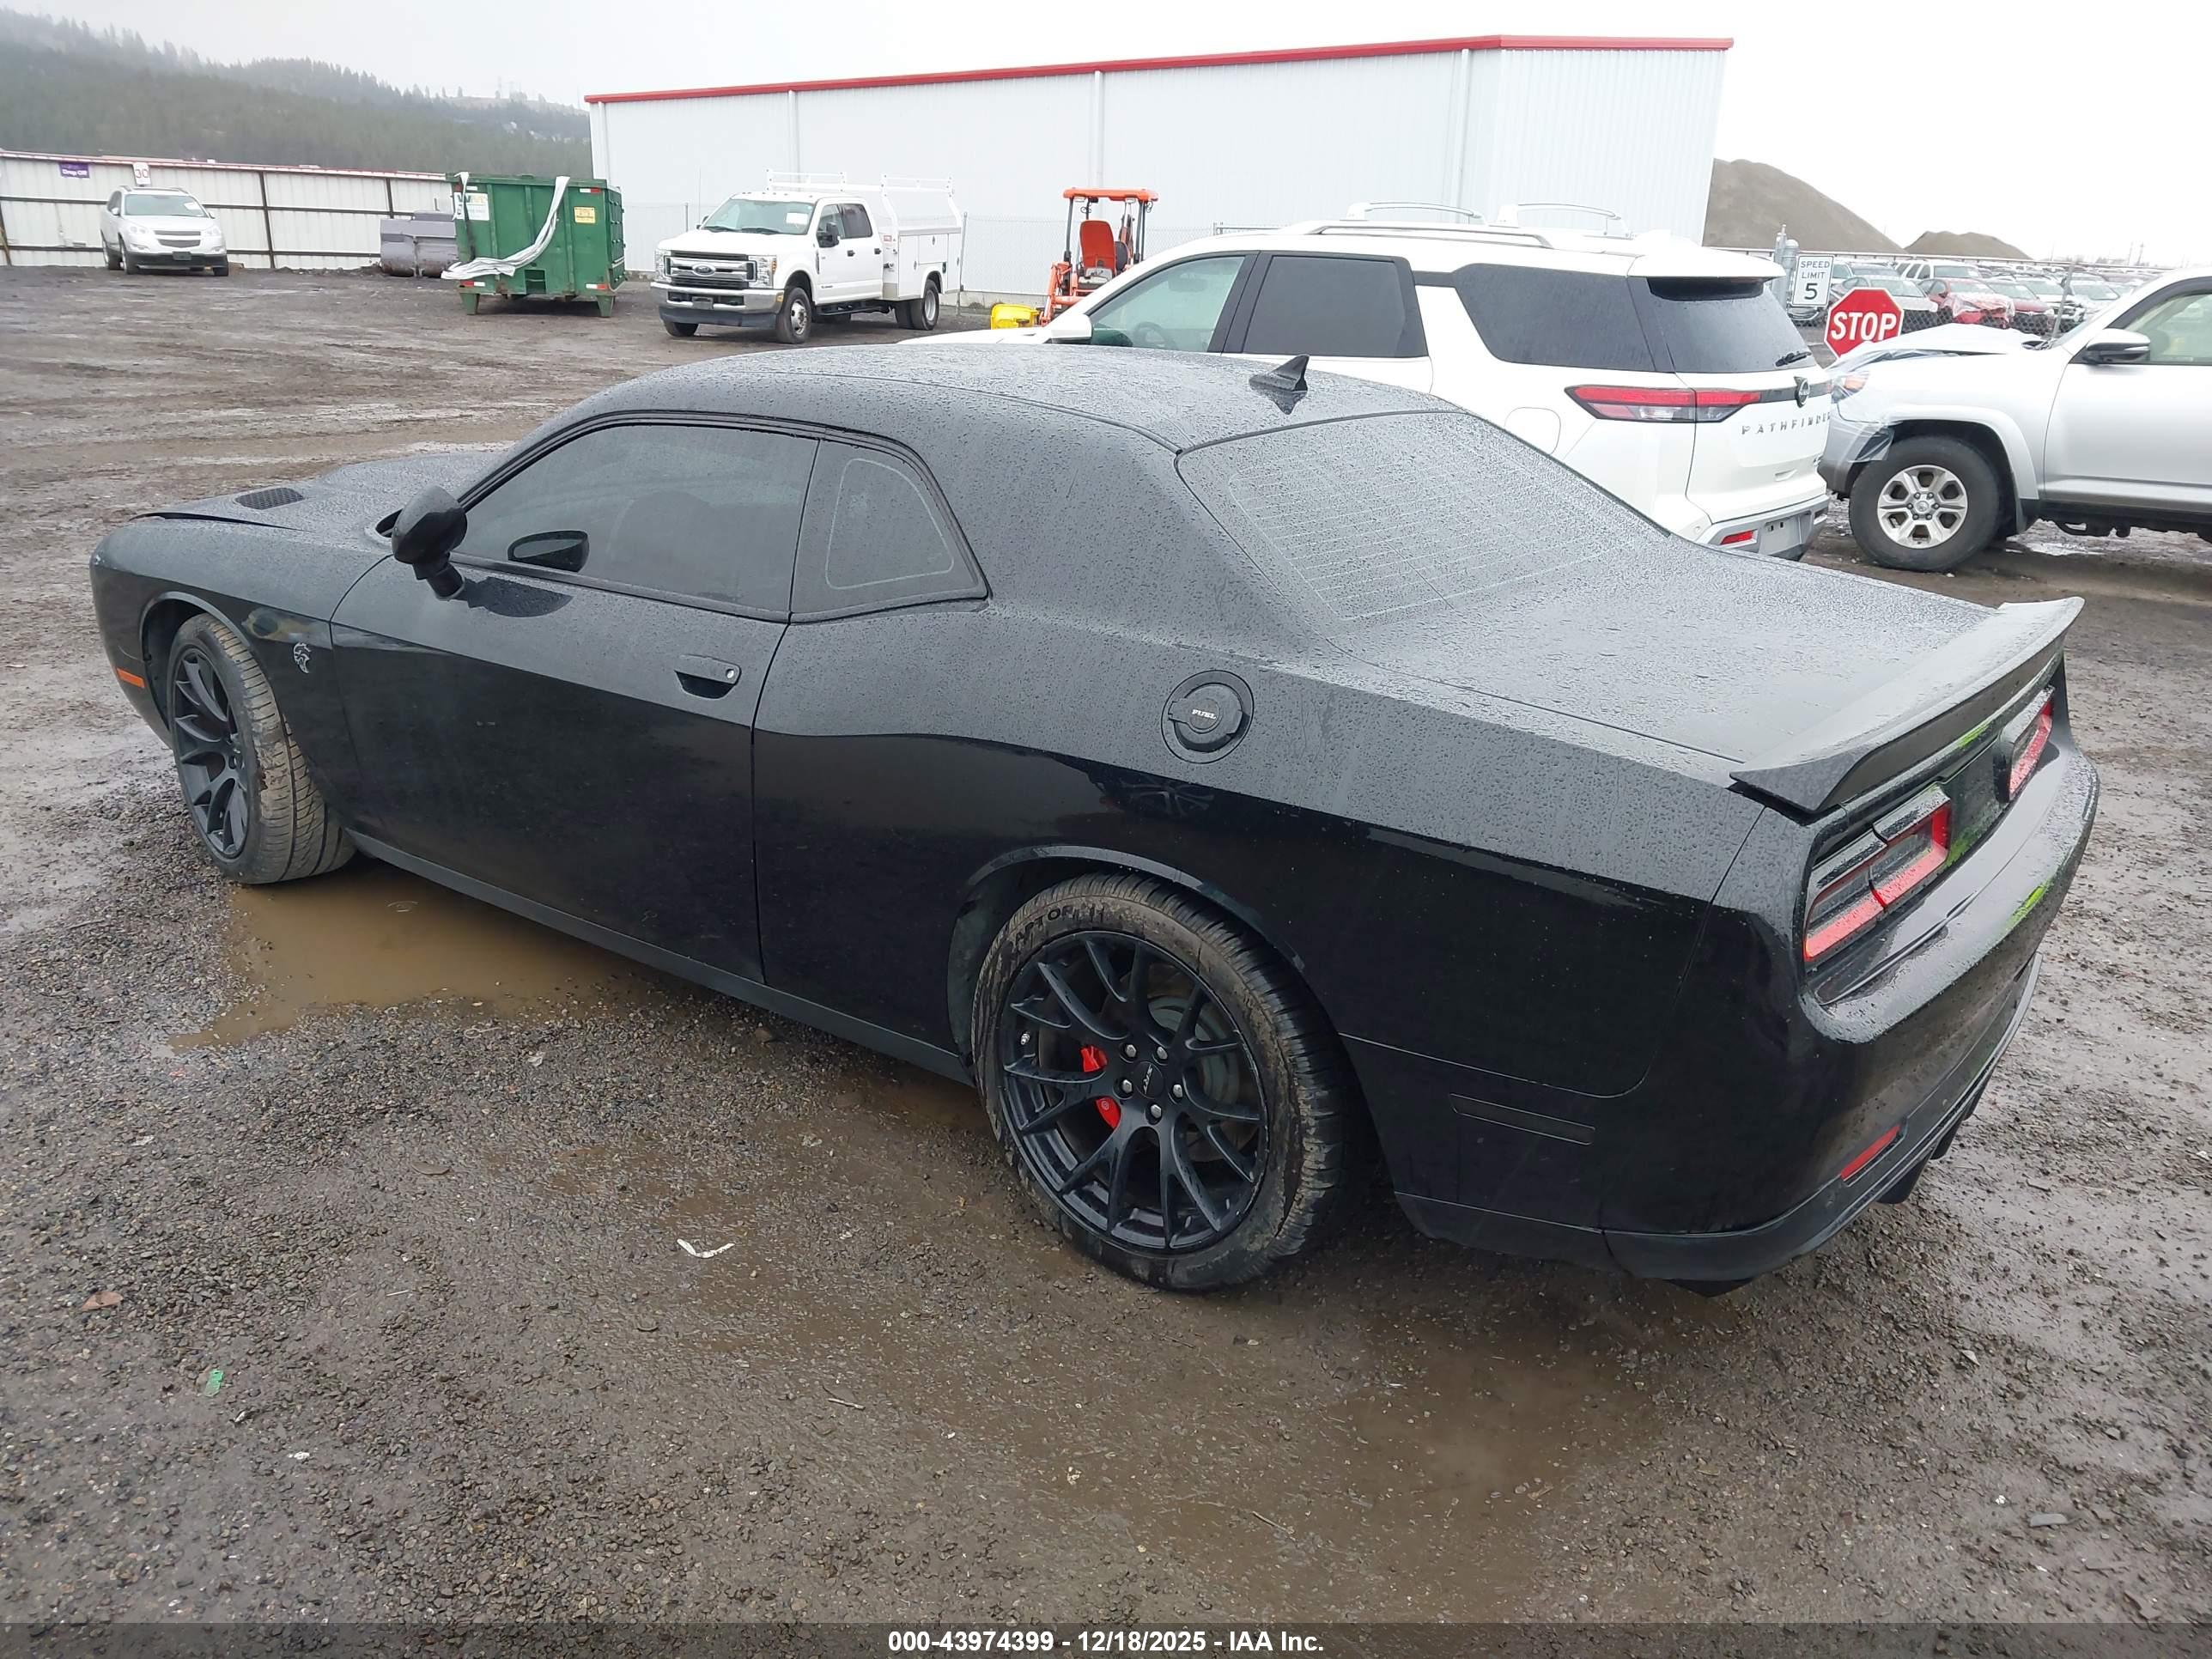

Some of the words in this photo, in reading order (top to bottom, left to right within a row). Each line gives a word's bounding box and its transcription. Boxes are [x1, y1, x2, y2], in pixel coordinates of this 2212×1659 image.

[135, 169, 149, 179] 30
[1804, 283, 1818, 300] 5
[1831, 312, 1897, 341] STOP
[1192, 709, 1217, 720] FUEL
[1143, 1065, 1152, 1094] SRT
